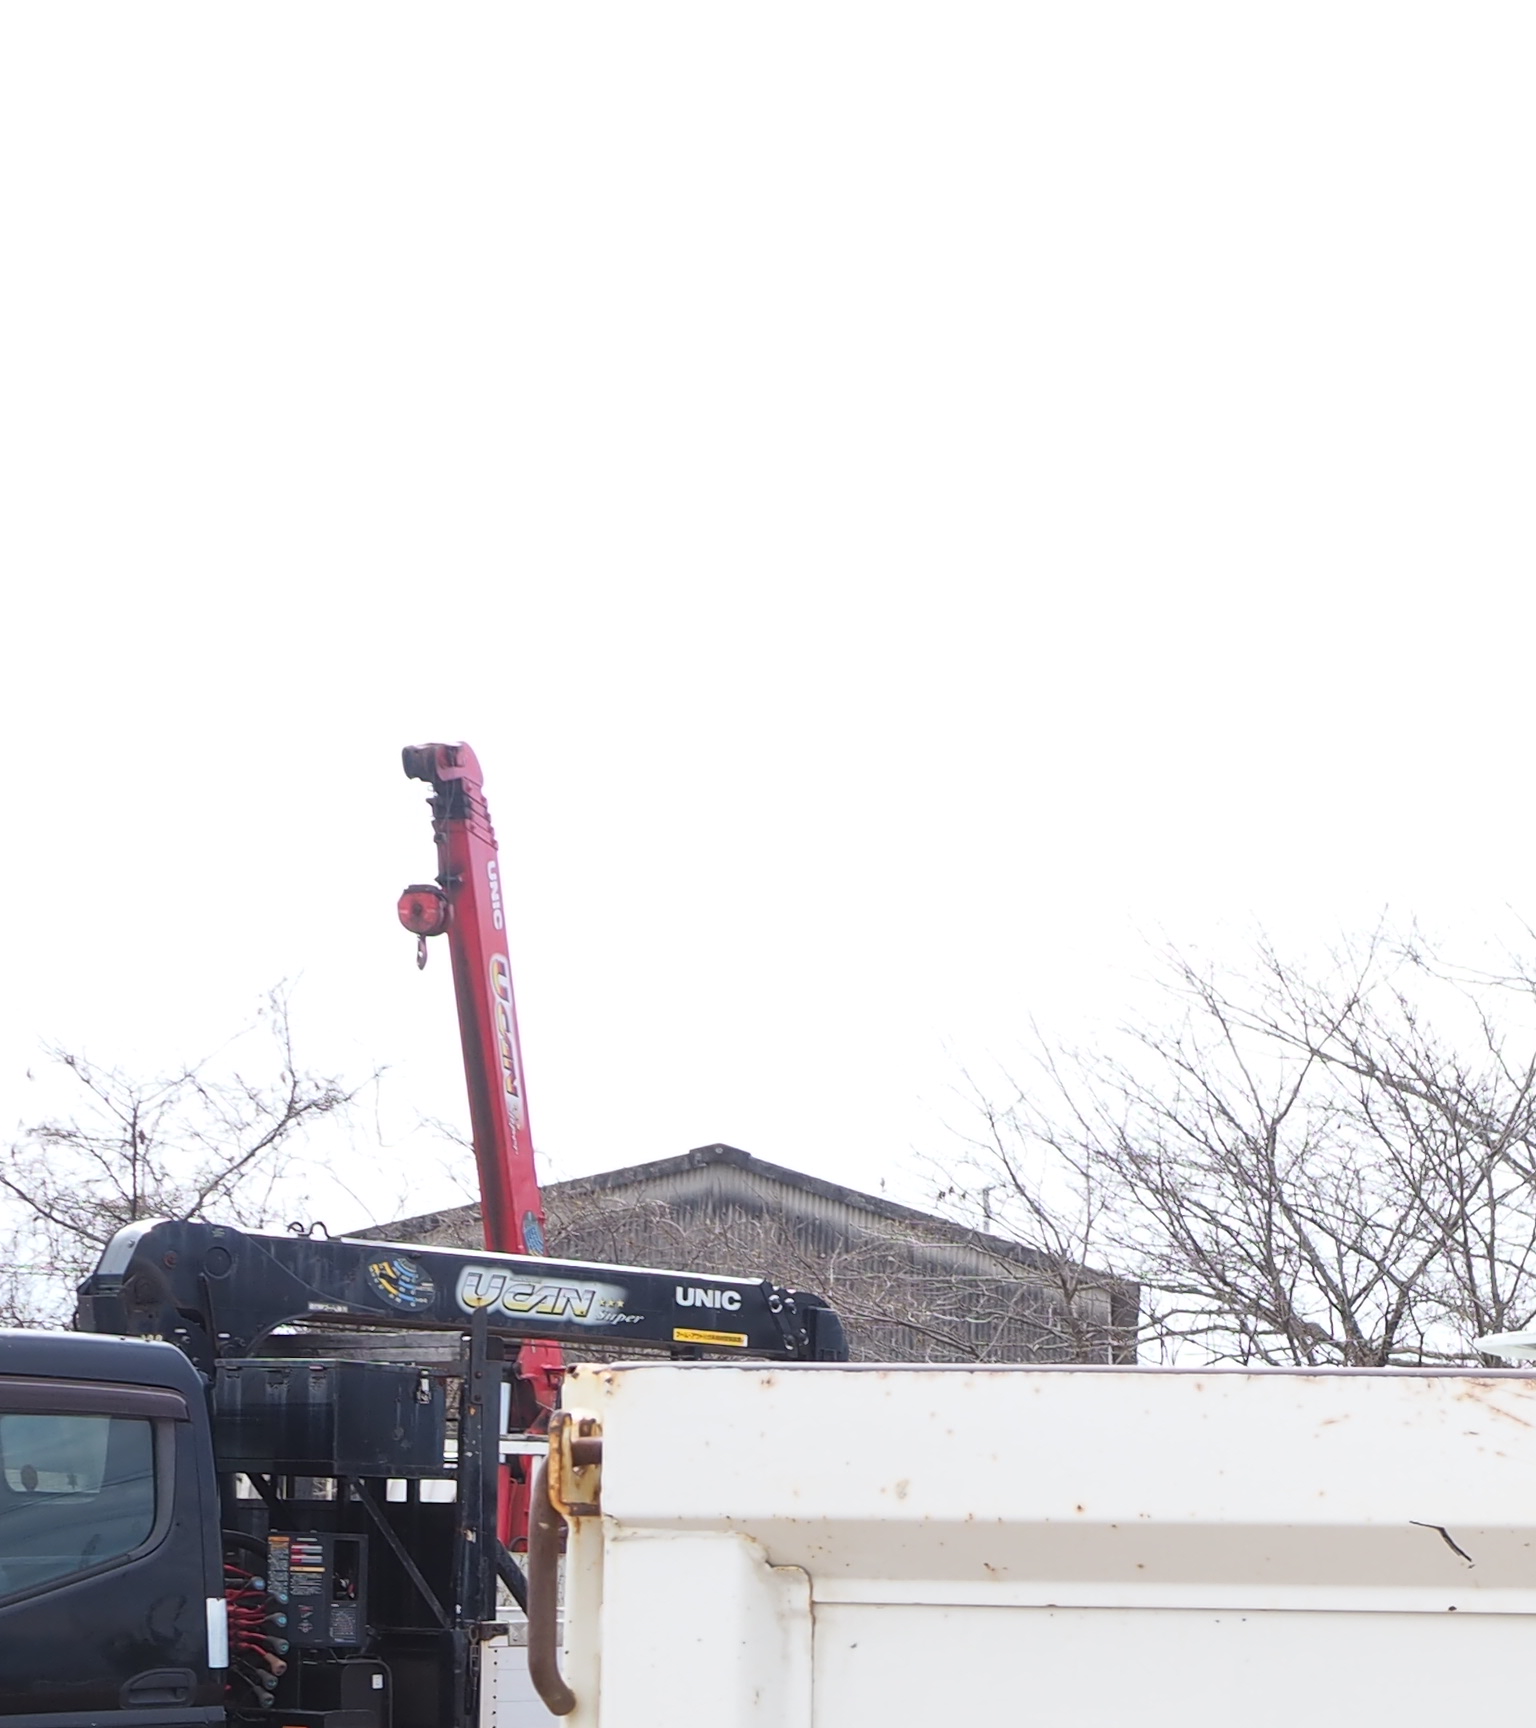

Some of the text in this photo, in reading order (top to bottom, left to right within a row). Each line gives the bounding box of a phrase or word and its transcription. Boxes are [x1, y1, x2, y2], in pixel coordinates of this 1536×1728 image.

[487, 860, 504, 931] UNIC
[675, 1285, 742, 1311] UNIC
[596, 1309, 645, 1326] Super
